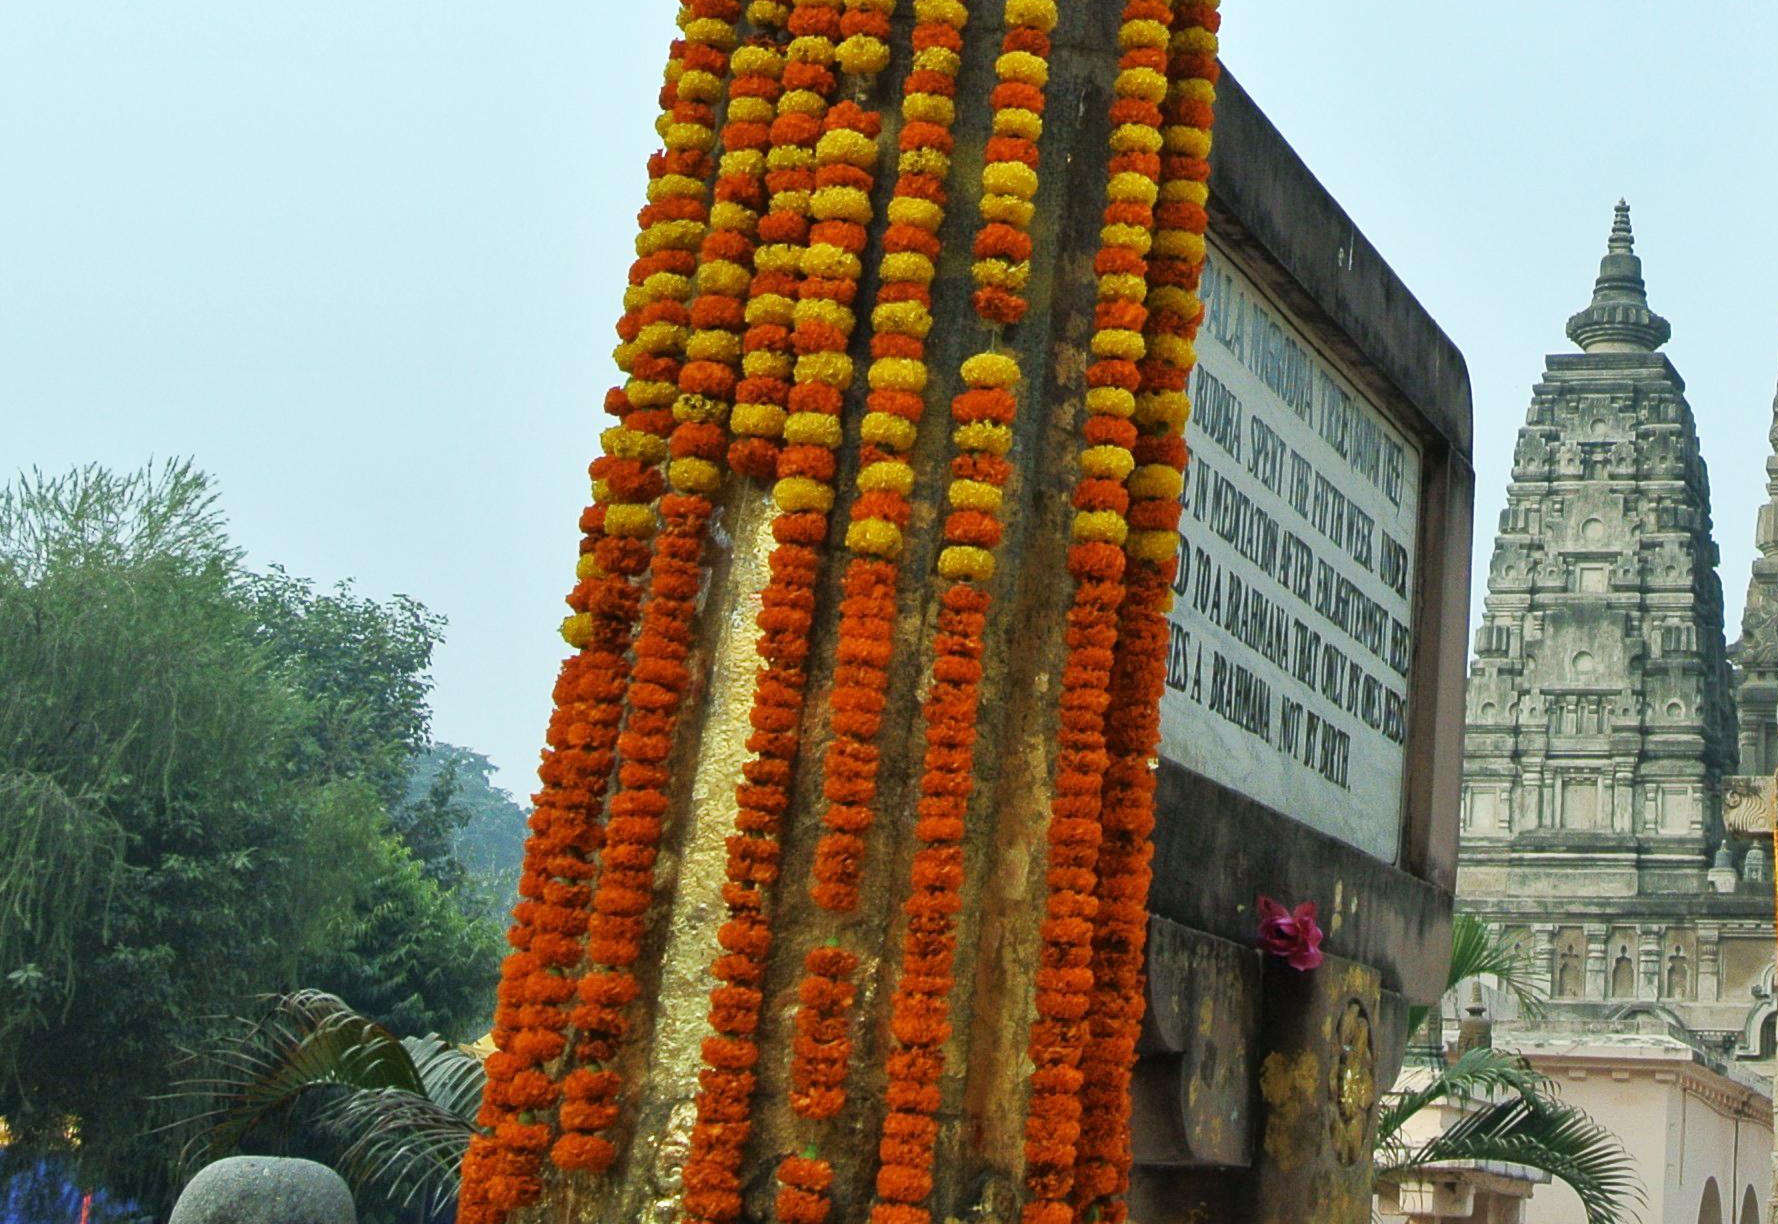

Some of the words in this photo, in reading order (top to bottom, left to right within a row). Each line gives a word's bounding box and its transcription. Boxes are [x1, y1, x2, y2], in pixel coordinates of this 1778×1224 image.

[1249, 303, 1314, 429] NIGRODHA
[1317, 370, 1350, 462] TREE
[1192, 363, 1243, 464] BUDDHA
[1247, 415, 1287, 498] SPENT
[1288, 449, 1313, 521] THE
[1311, 470, 1345, 549] FIFTH
[1345, 498, 1375, 573] WEEK
[1379, 528, 1409, 600] UNDER
[1193, 457, 1210, 523] IN
[1209, 470, 1279, 579] MEDITATION
[1277, 529, 1314, 606] AFTER
[1190, 640, 1203, 705] A
[1208, 650, 1271, 744] BRAHMANA
[1277, 693, 1304, 760] NOT
[1303, 709, 1320, 770] BY
[1318, 718, 1351, 793] BIRTH.
[1192, 545, 1212, 615] TO
[1209, 564, 1222, 627] A
[1224, 570, 1290, 672] BRAHMANA
[1292, 618, 1320, 691] THAT
[1320, 642, 1347, 710] ONLY
[1346, 659, 1363, 718] BY
[1381, 685, 1405, 745] DEEDS
